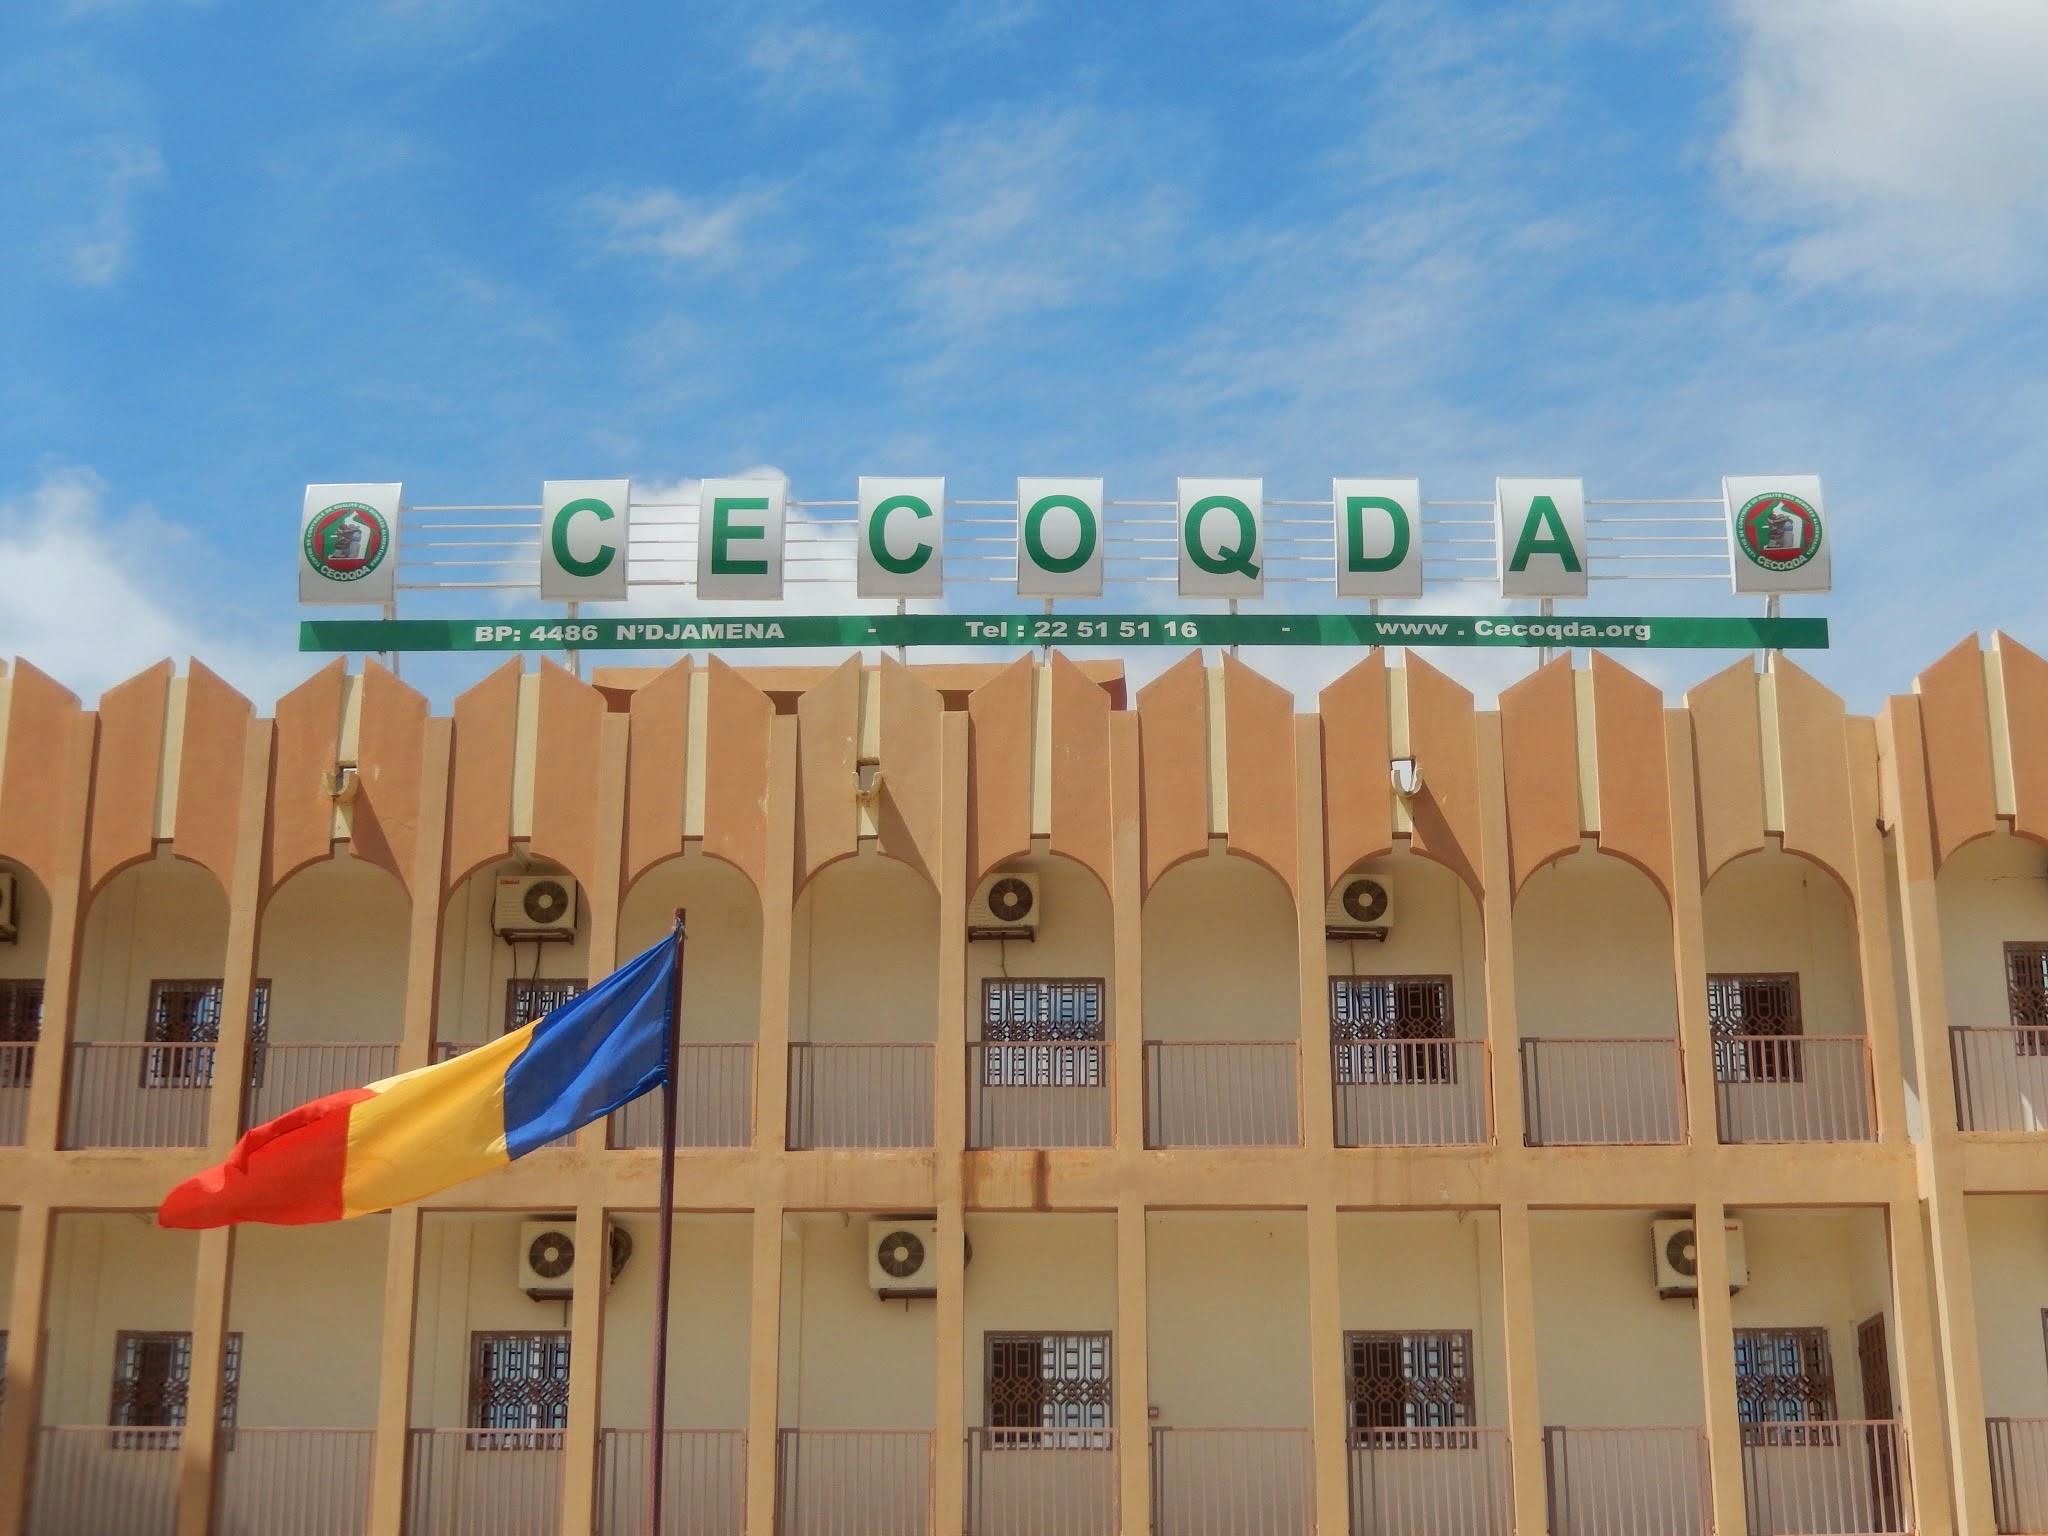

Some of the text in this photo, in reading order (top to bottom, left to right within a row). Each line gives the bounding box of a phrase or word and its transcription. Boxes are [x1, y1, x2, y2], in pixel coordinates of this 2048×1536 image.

[1757, 555, 1807, 570] CECOQDA
[321, 566, 370, 580] CECOQDA
[475, 626, 520, 643] BP:
[529, 625, 599, 642] 4486
[965, 621, 1008, 638] Tel
[1033, 621, 1068, 638] 22
[1076, 621, 1108, 638] 51
[1119, 621, 1150, 638] 51
[1163, 621, 1198, 638] 16
[1375, 622, 1449, 636] www
[1474, 619, 1651, 641] Cecoqda.org
